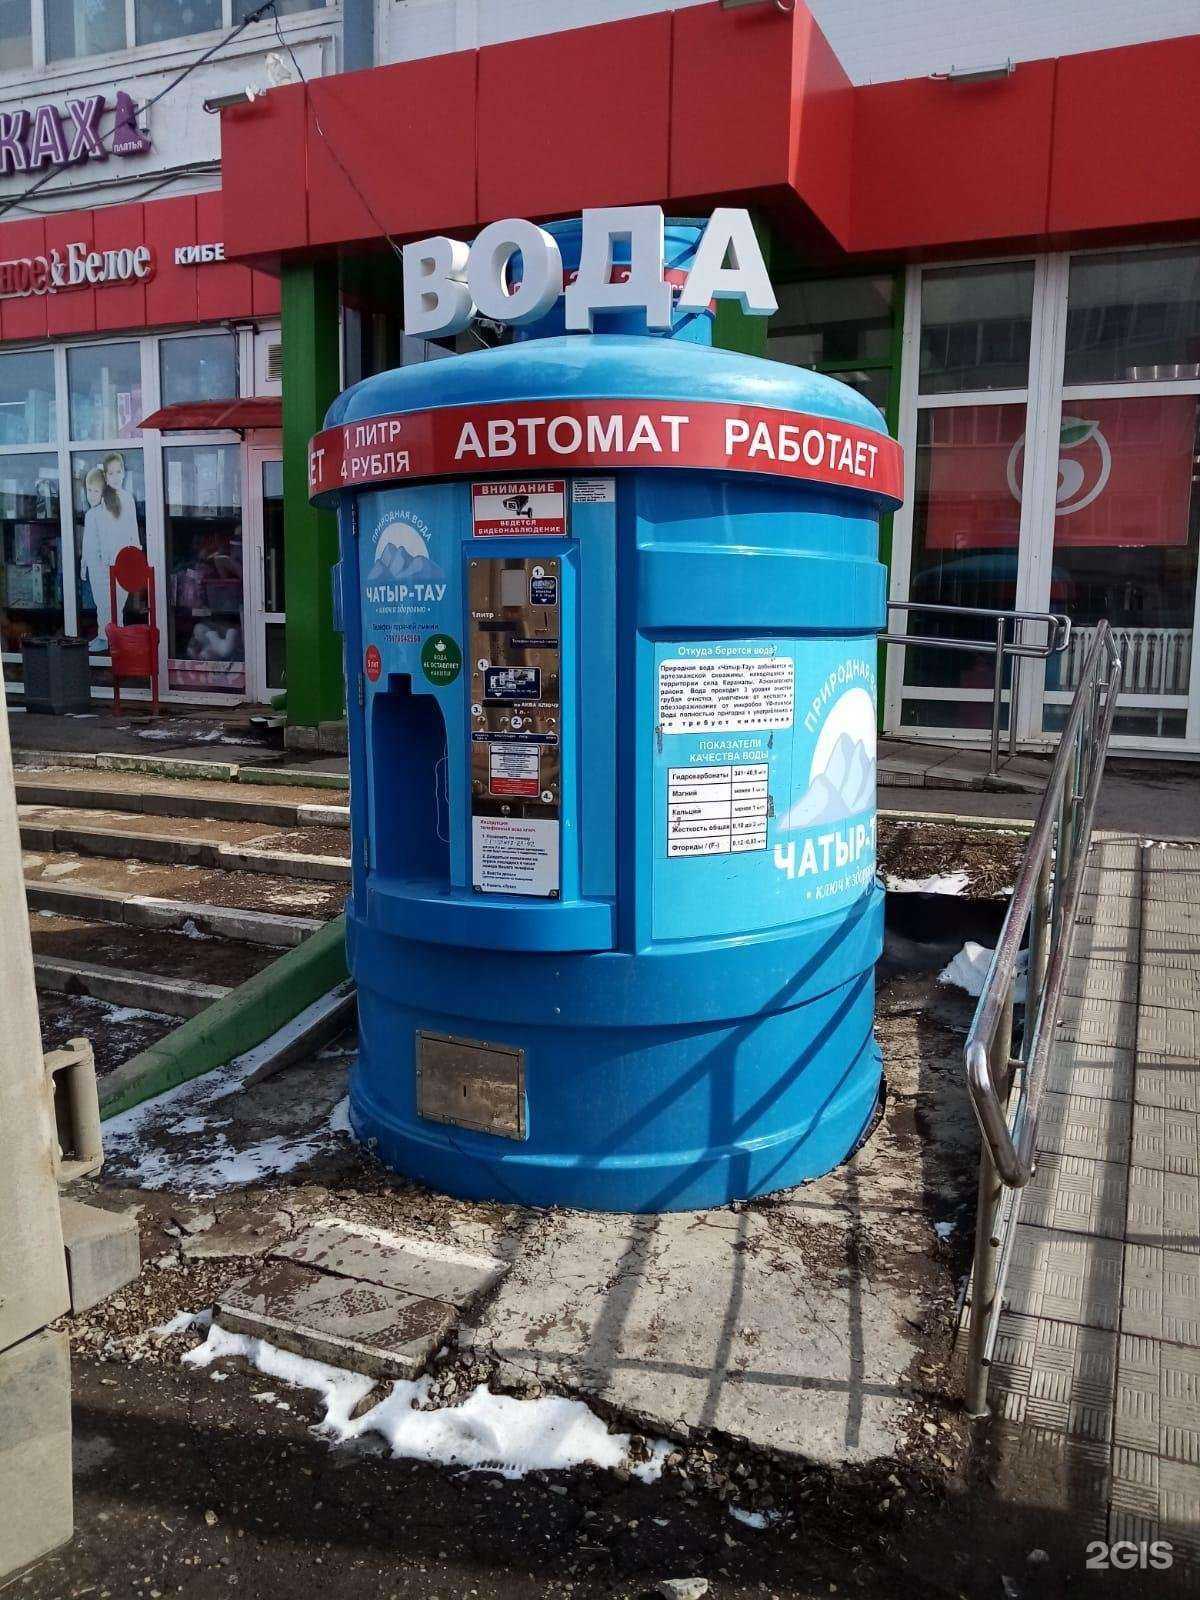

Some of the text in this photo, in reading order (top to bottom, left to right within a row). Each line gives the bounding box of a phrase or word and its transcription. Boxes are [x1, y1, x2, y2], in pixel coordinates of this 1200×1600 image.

[402, 205, 778, 336] ВОДА
[344, 420, 401, 449] 1 ЛИТР
[455, 415, 878, 478] АВТОМАТ РАБОТАЕТ
[340, 451, 410, 480] 4 РУБЛЯ
[481, 483, 555, 495] ВНИМАНИЕ
[371, 508, 432, 544] ПРИРОДНАЯ ВОДА
[478, 526, 561, 535] ВИДЕОНАБЛЮДЕНИЕ
[366, 584, 447, 603] ЧАТЫР-ТАУ
[678, 646, 713, 656] Откуда
[804, 657, 870, 733] ПРИРОДНАЯ
[689, 750, 769, 762] КАЧЕСТВА ВОДЫ
[700, 739, 762, 750] ПОКАЗАТЕЛИ
